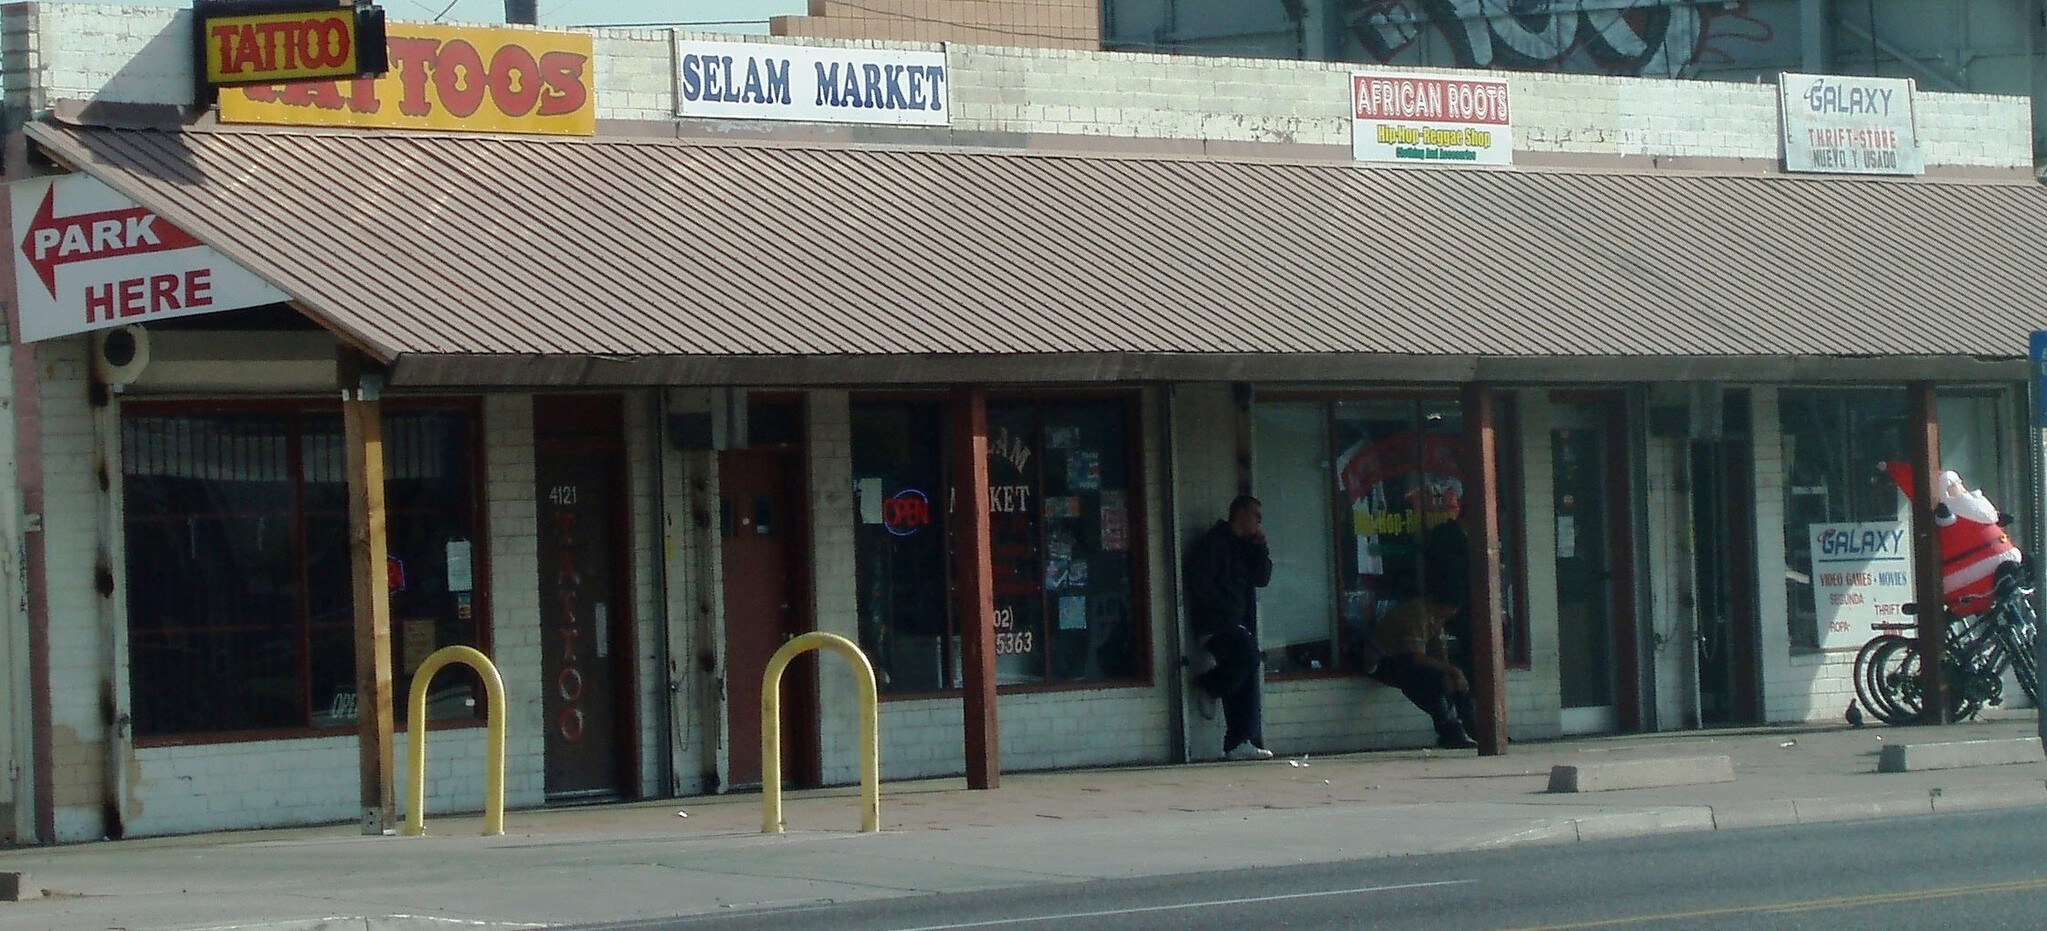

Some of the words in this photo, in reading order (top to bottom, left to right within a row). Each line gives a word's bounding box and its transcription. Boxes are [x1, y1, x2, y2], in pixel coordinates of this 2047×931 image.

[211, 17, 351, 74] TATTOO
[682, 53, 792, 105] SELAM
[814, 61, 944, 111] MARKET
[1804, 78, 1893, 117] GALAXY
[1357, 78, 1443, 118] AFRICAN
[1448, 82, 1508, 122] ROOTS
[1465, 128, 1492, 149] Shop
[1812, 149, 1847, 168] NUEVO
[1851, 150, 1858, 168] Y
[1863, 150, 1897, 169] USADO
[34, 214, 161, 260] PARK
[84, 268, 213, 324] HERE
[549, 485, 577, 505] 4121
[883, 496, 931, 527] OPEN
[1818, 528, 1904, 555] GALAXY
[1820, 572, 1843, 587] VIDEO
[1846, 572, 1872, 587] GAMES
[1878, 571, 1908, 587] MOVIES
[1874, 603, 1901, 616] THRIFT
[555, 512, 585, 743] TATTOO
[331, 692, 358, 719] OPE
